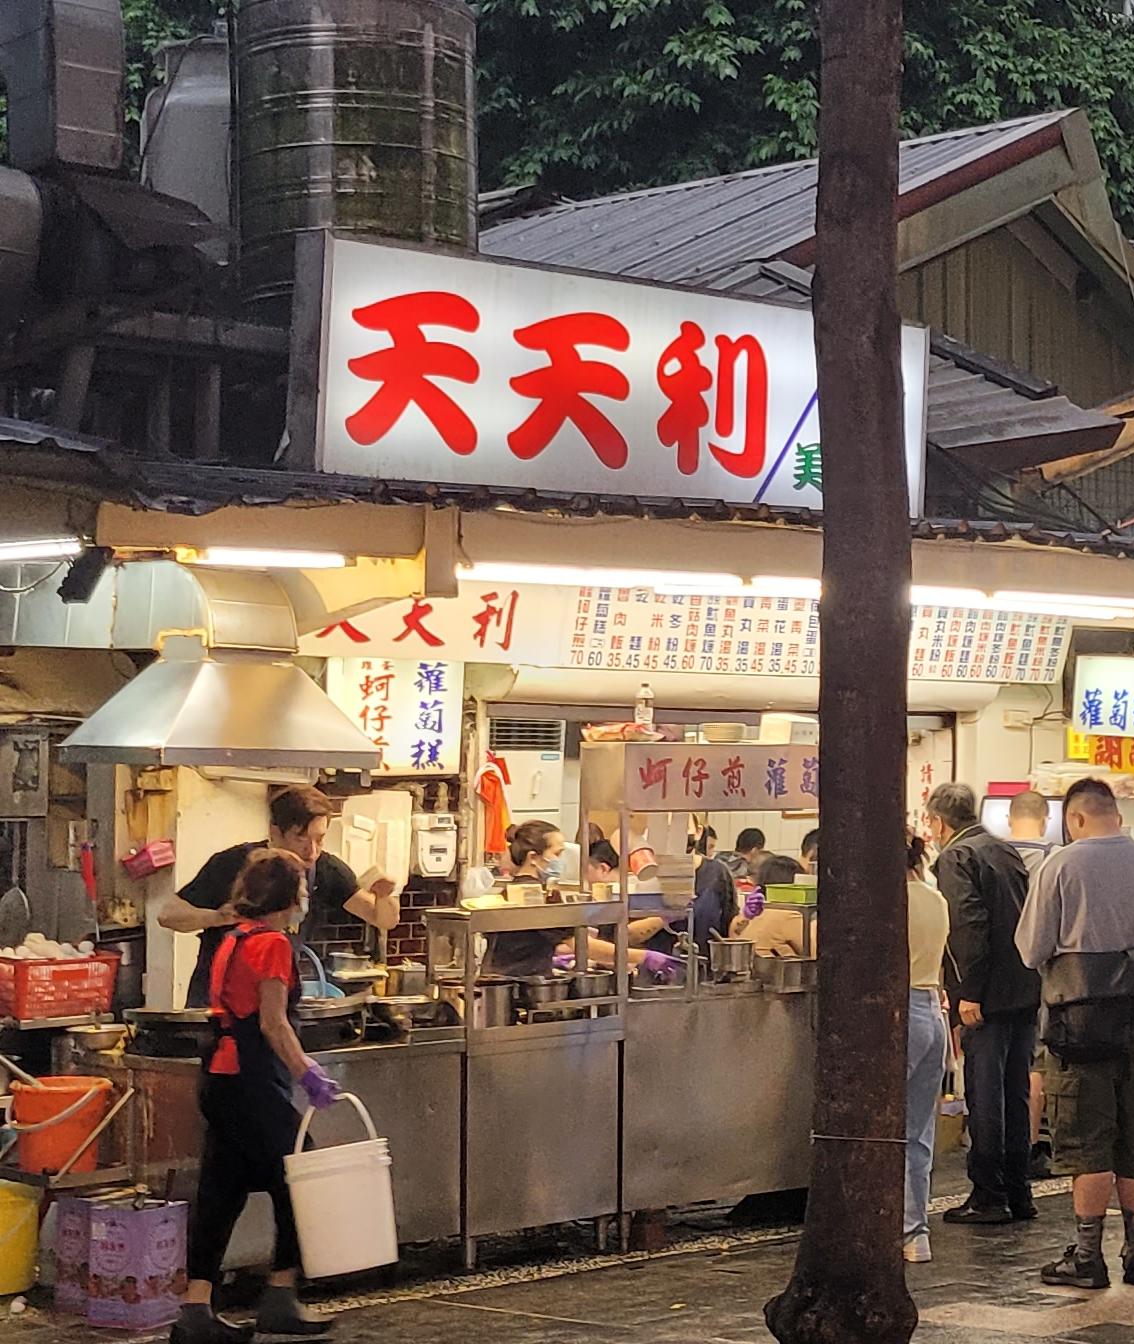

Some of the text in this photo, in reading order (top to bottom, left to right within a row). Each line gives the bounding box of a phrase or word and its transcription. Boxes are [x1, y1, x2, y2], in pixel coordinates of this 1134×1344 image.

[345, 290, 768, 478] 天天利
[315, 590, 519, 651] 天利
[571, 650, 583, 665] 70
[588, 651, 602, 666] 60
[607, 652, 621, 667] 35
[626, 654, 640, 668] 45
[644, 655, 658, 669] 45
[664, 655, 677, 669] 45
[682, 655, 695, 669] 60
[700, 657, 713, 670] 70
[716, 657, 729, 671] 35
[735, 658, 748, 672] 35
[751, 658, 763, 672] 45
[785, 660, 797, 673] 45
[801, 660, 815, 674] 30
[956, 664, 968, 678] 60
[986, 665, 998, 678] 60
[639, 756, 746, 799] 蚵仔煎
